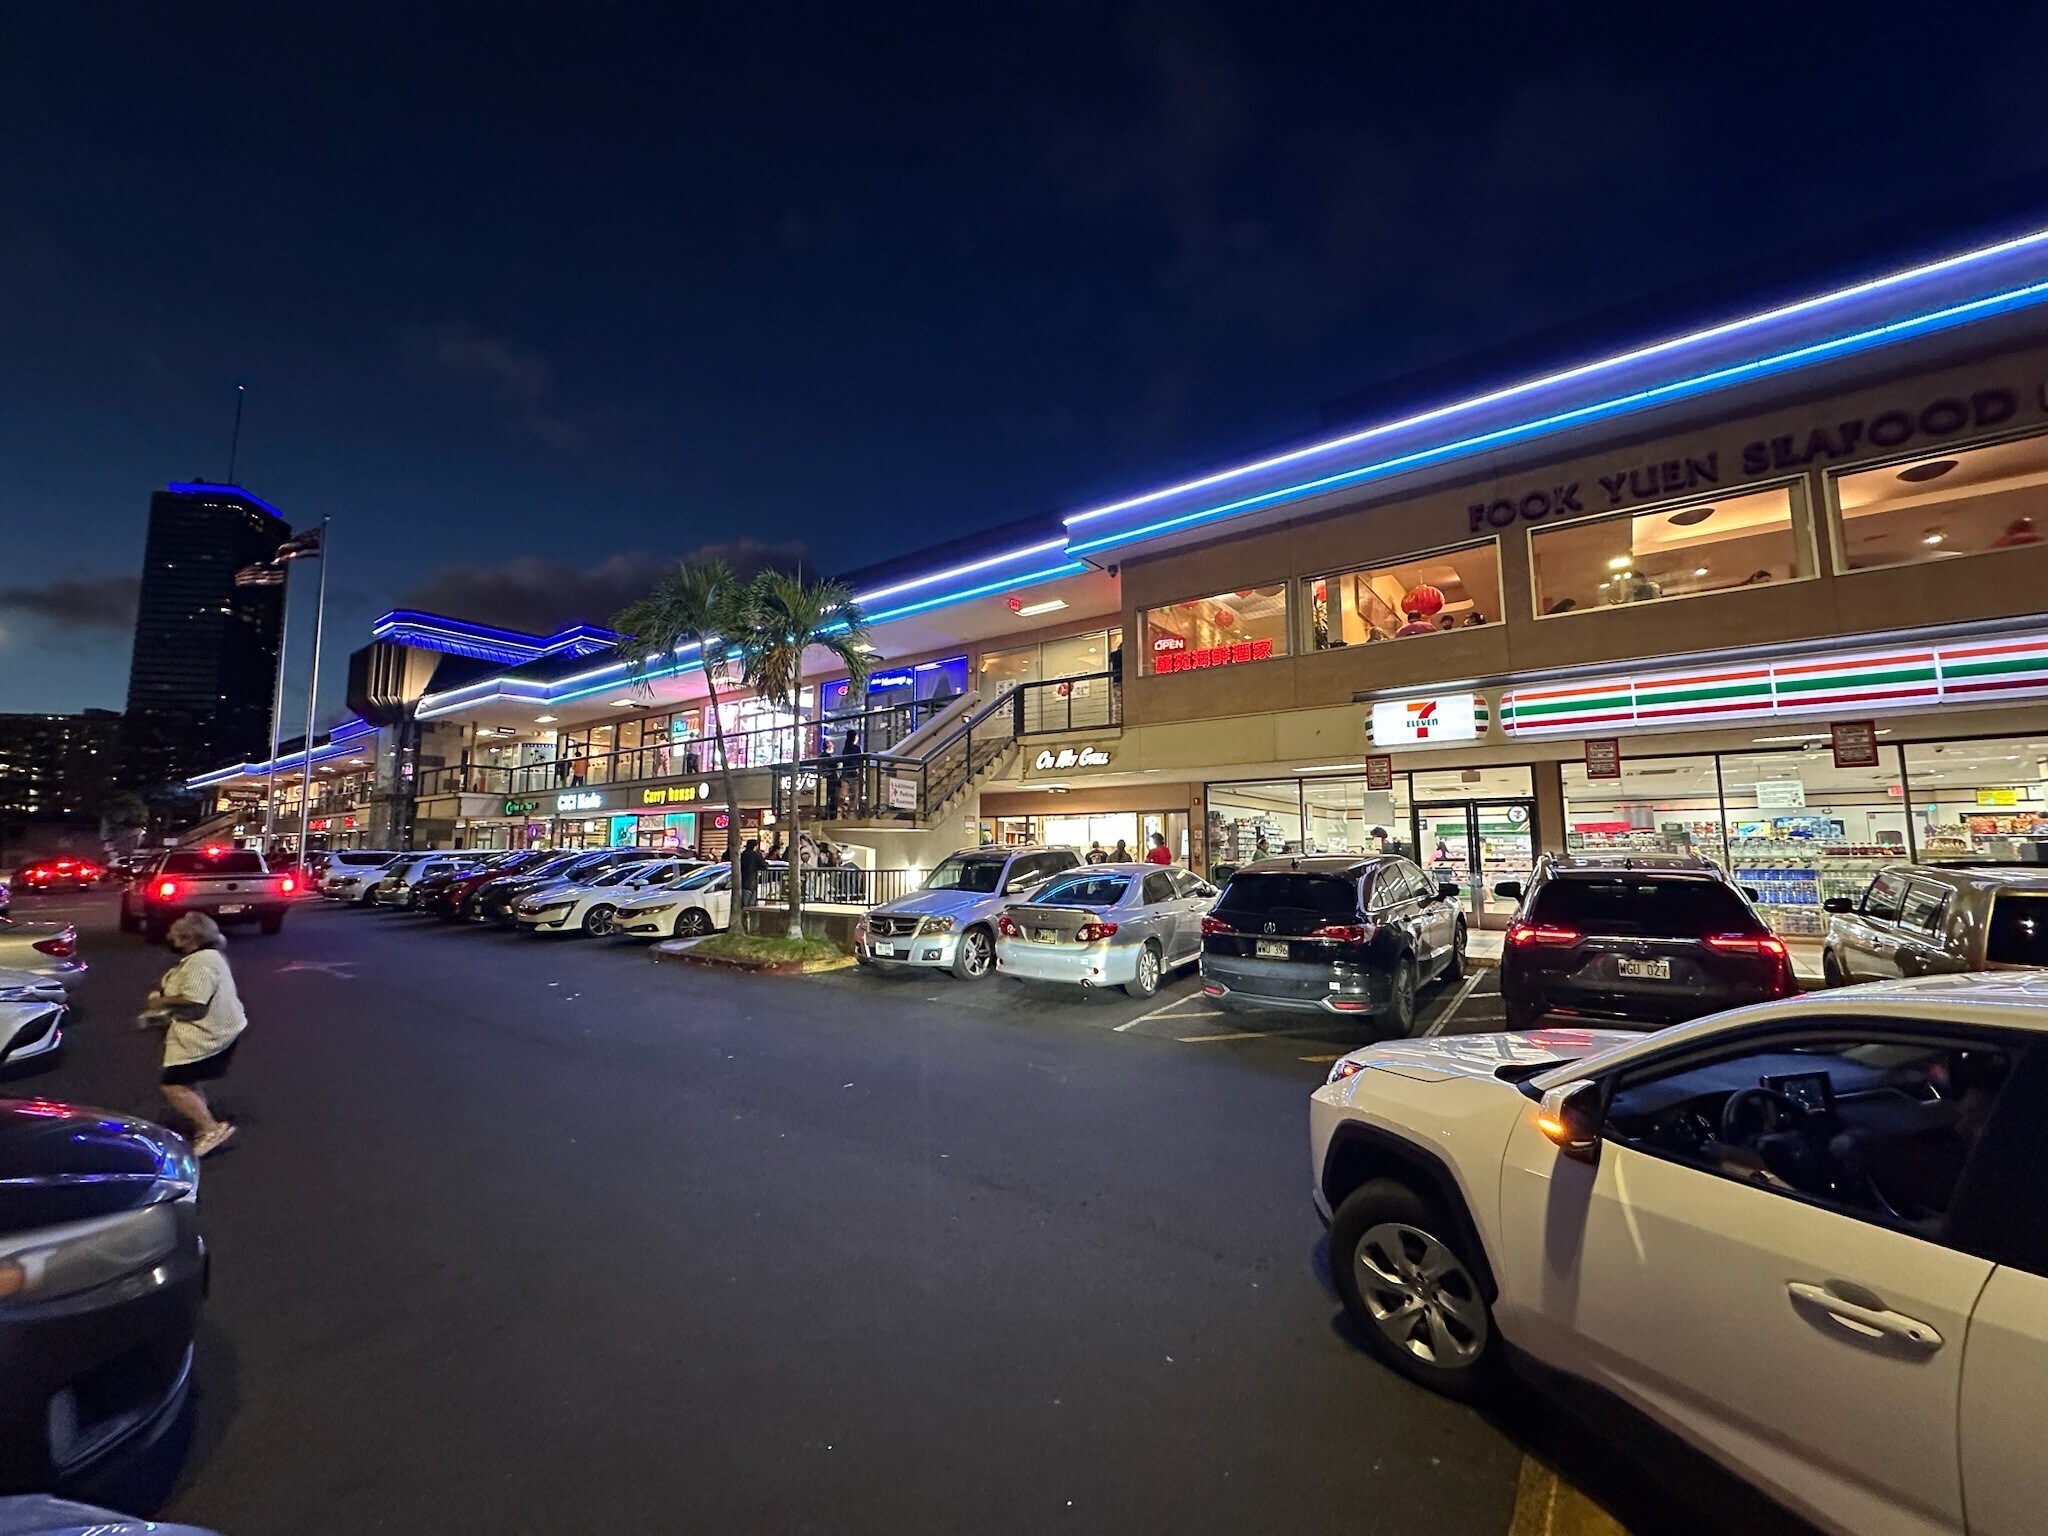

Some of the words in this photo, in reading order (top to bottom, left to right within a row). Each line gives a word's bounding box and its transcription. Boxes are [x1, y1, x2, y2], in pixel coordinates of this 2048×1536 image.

[1468, 481, 1583, 533] FOOK
[1599, 450, 1719, 505] YUEN
[1741, 387, 2019, 477] SEAFOOD
[1154, 639, 1184, 651] OPEN
[1407, 701, 1437, 738] 7
[643, 788, 666, 804] Curry
[668, 787, 696, 802] house
[1647, 964, 1667, 977] 027
